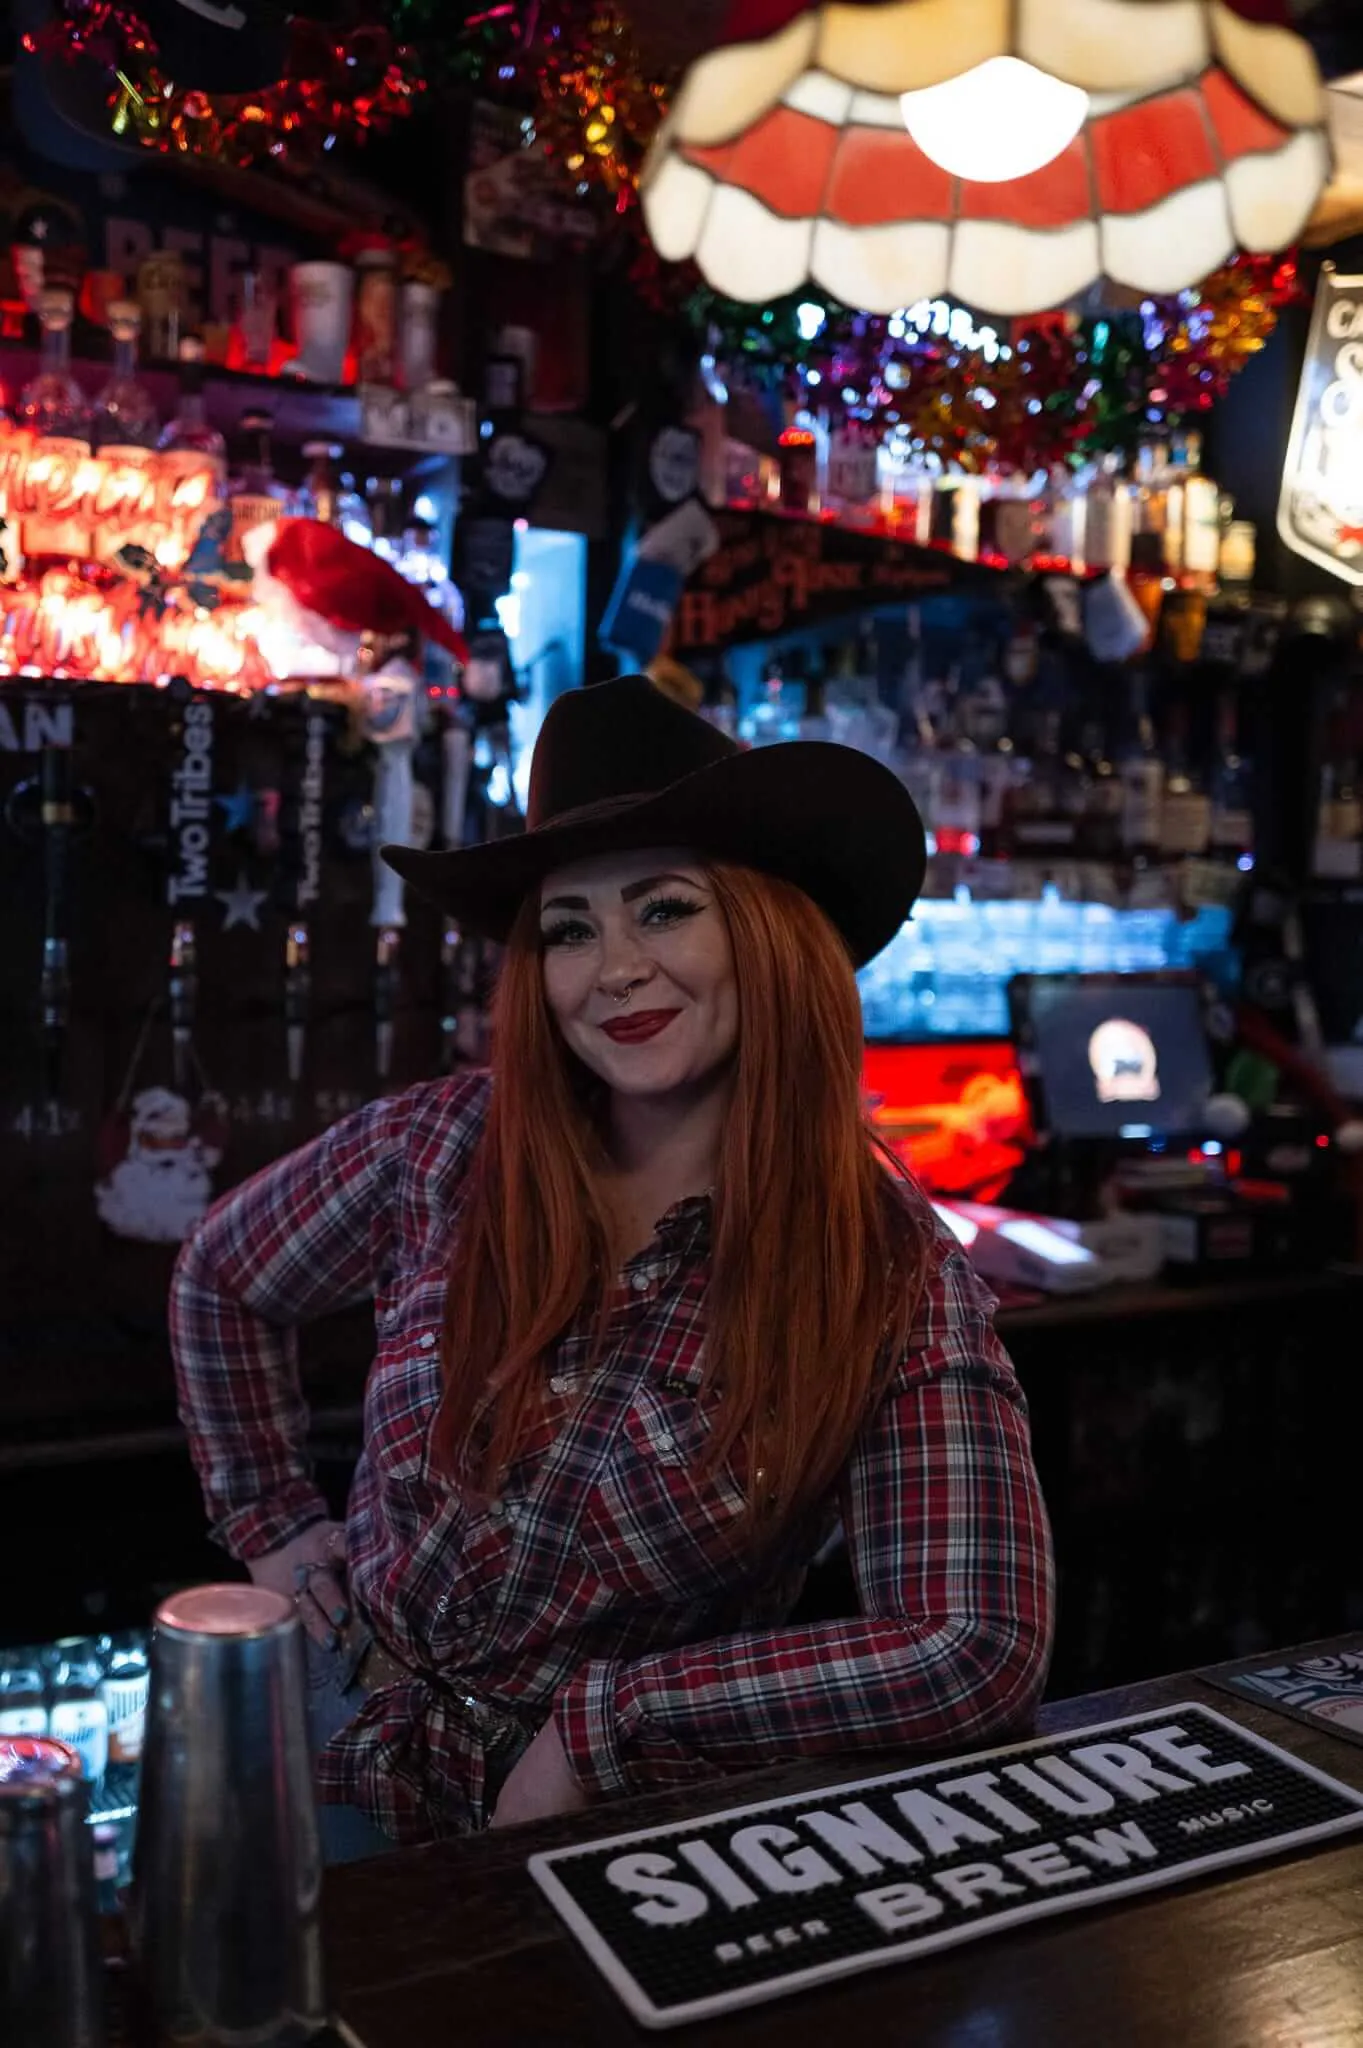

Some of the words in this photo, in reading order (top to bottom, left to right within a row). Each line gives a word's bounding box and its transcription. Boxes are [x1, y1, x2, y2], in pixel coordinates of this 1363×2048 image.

[606, 1726, 1252, 1926] SIGNATURE
[714, 1920, 832, 1963] BEER
[855, 1822, 1157, 1931] BREW
[1176, 1799, 1275, 1835] MUSIC
